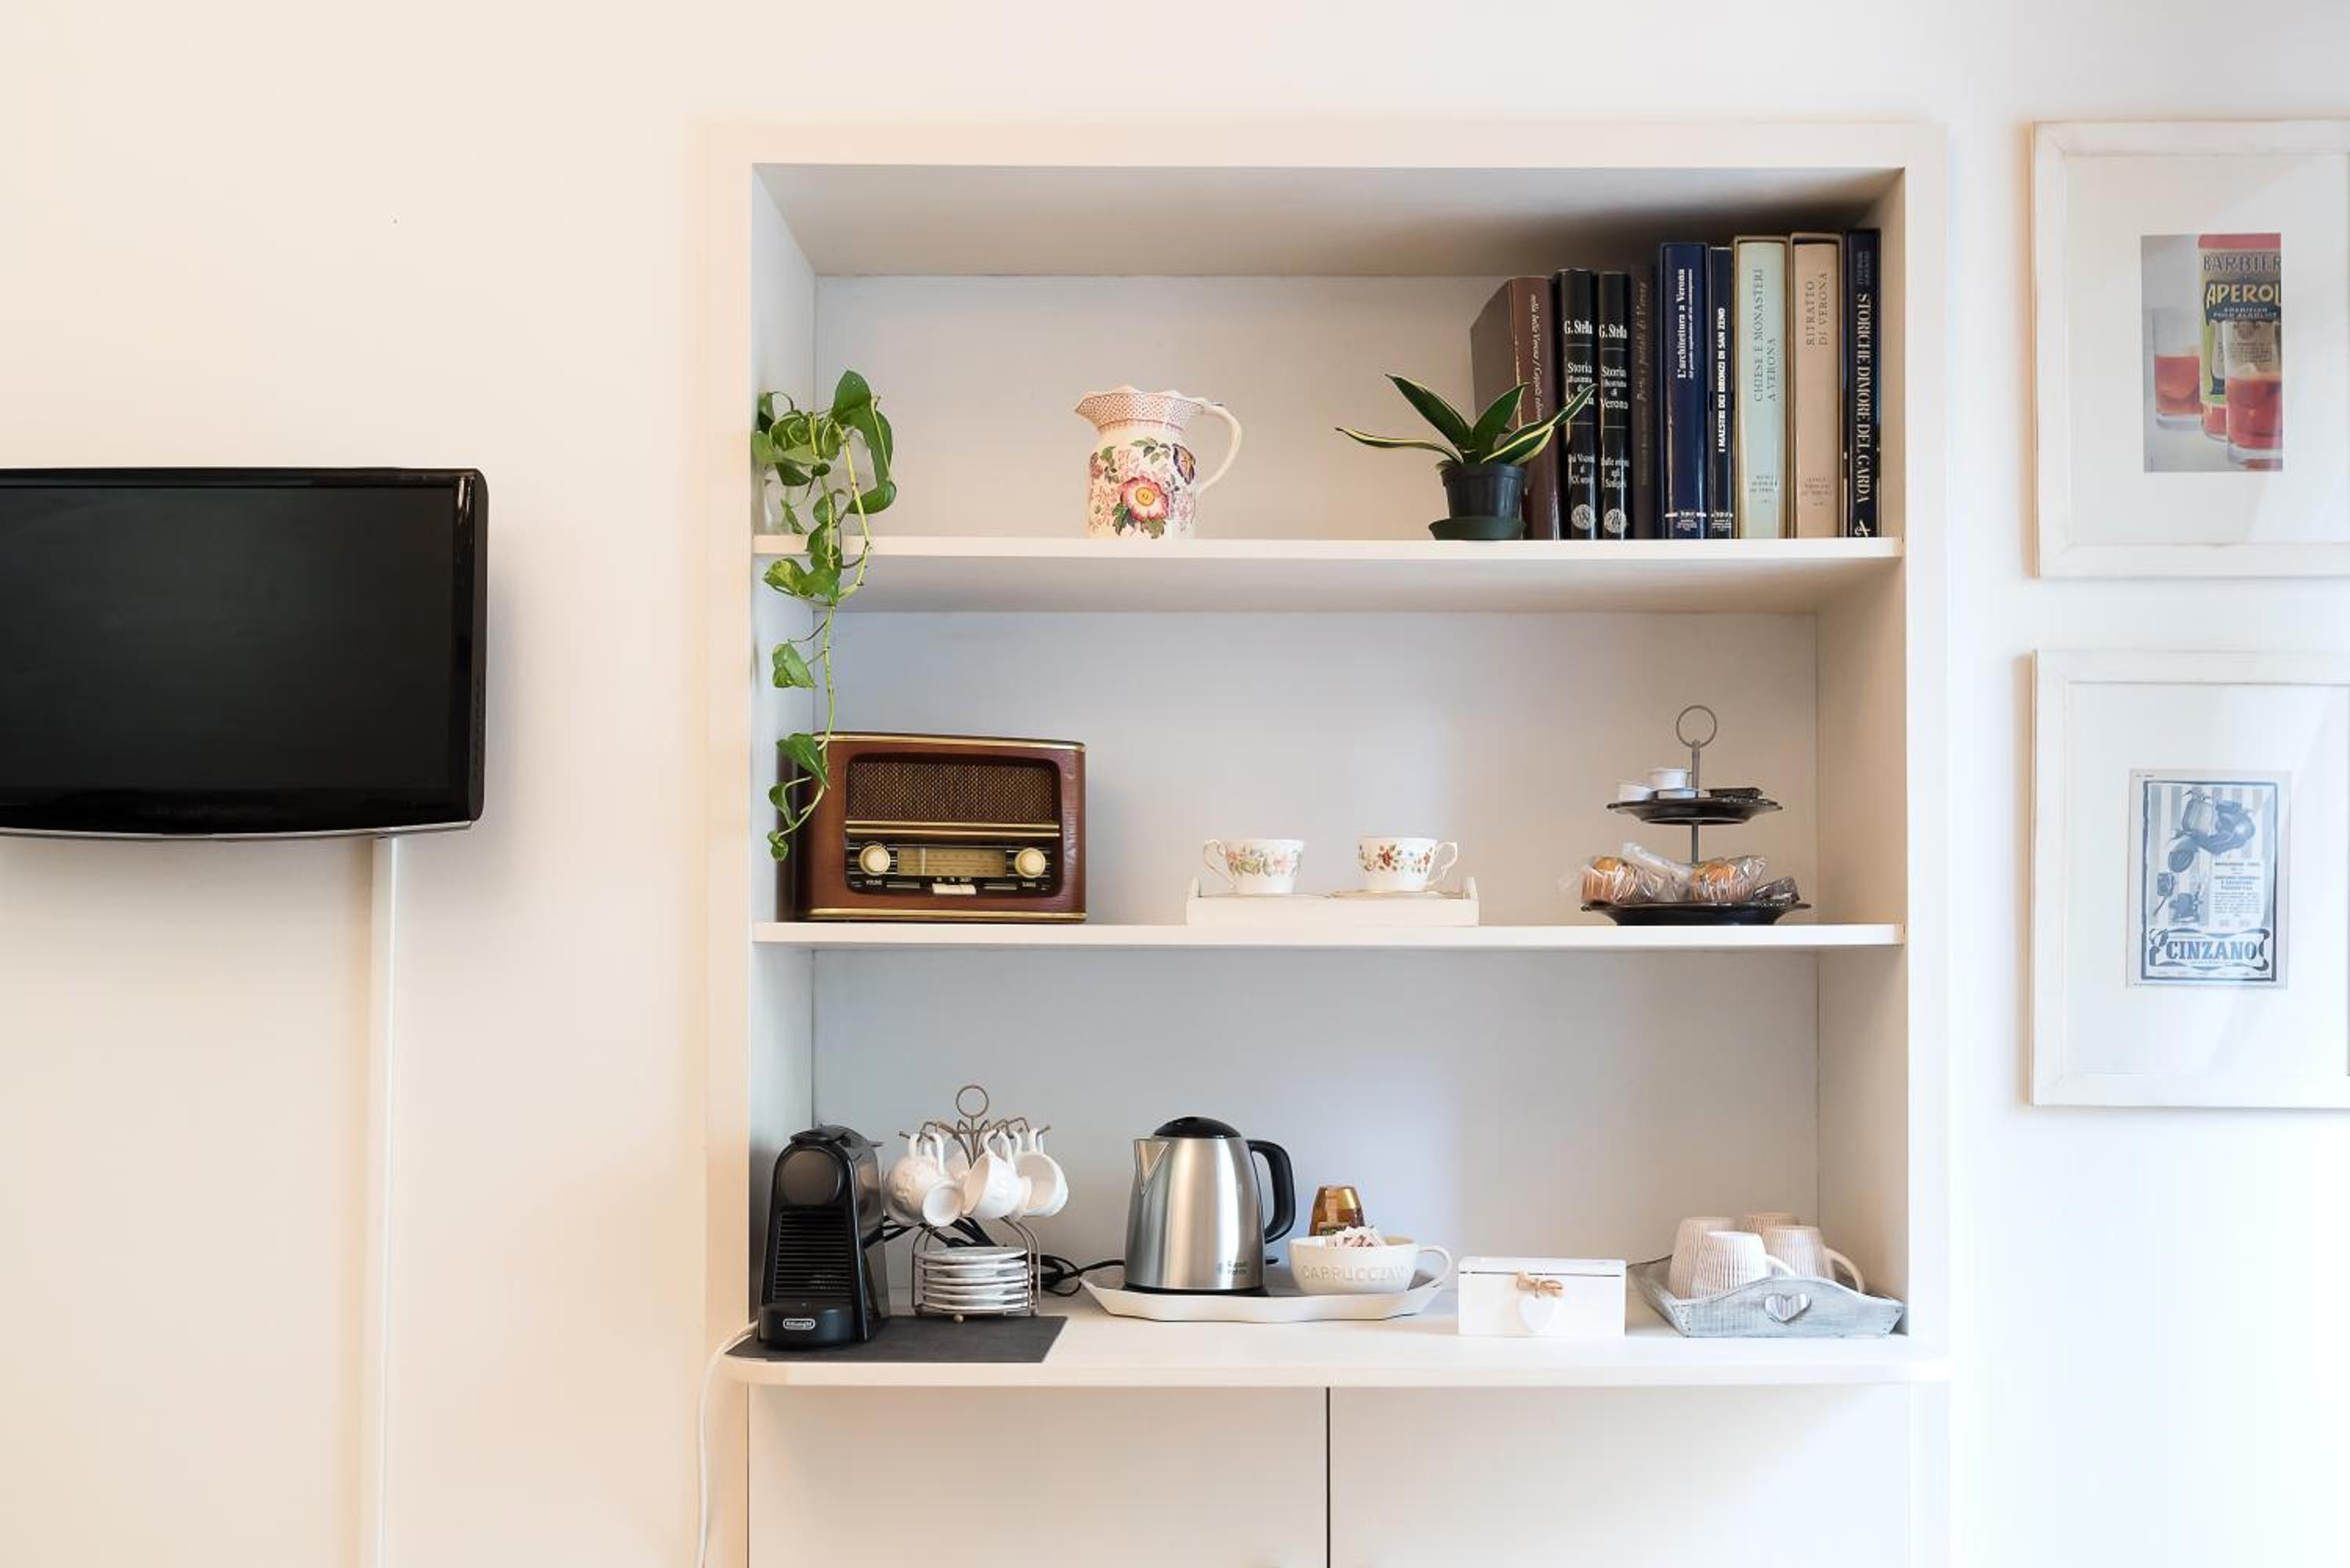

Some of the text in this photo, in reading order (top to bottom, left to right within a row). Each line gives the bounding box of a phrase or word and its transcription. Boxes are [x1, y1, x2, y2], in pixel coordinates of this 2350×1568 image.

[1676, 269, 1686, 302] Verona
[1753, 269, 1763, 341] MONASTERI
[1805, 281, 1815, 345] RITRATTO
[1818, 273, 1828, 345] DI VERONA
[1856, 293, 1871, 363] STORICHE
[1567, 362, 1593, 374] Storia
[1601, 366, 1626, 378] Storia
[1754, 357, 1763, 402] CHIESE
[1766, 338, 1776, 388] VERONA
[1600, 398, 1629, 410] Verona
[1856, 366, 1871, 421] DIMORE
[1856, 424, 1871, 453] DEL
[1856, 455, 1871, 503] GARDA
[2166, 940, 2258, 959] CINZANO
